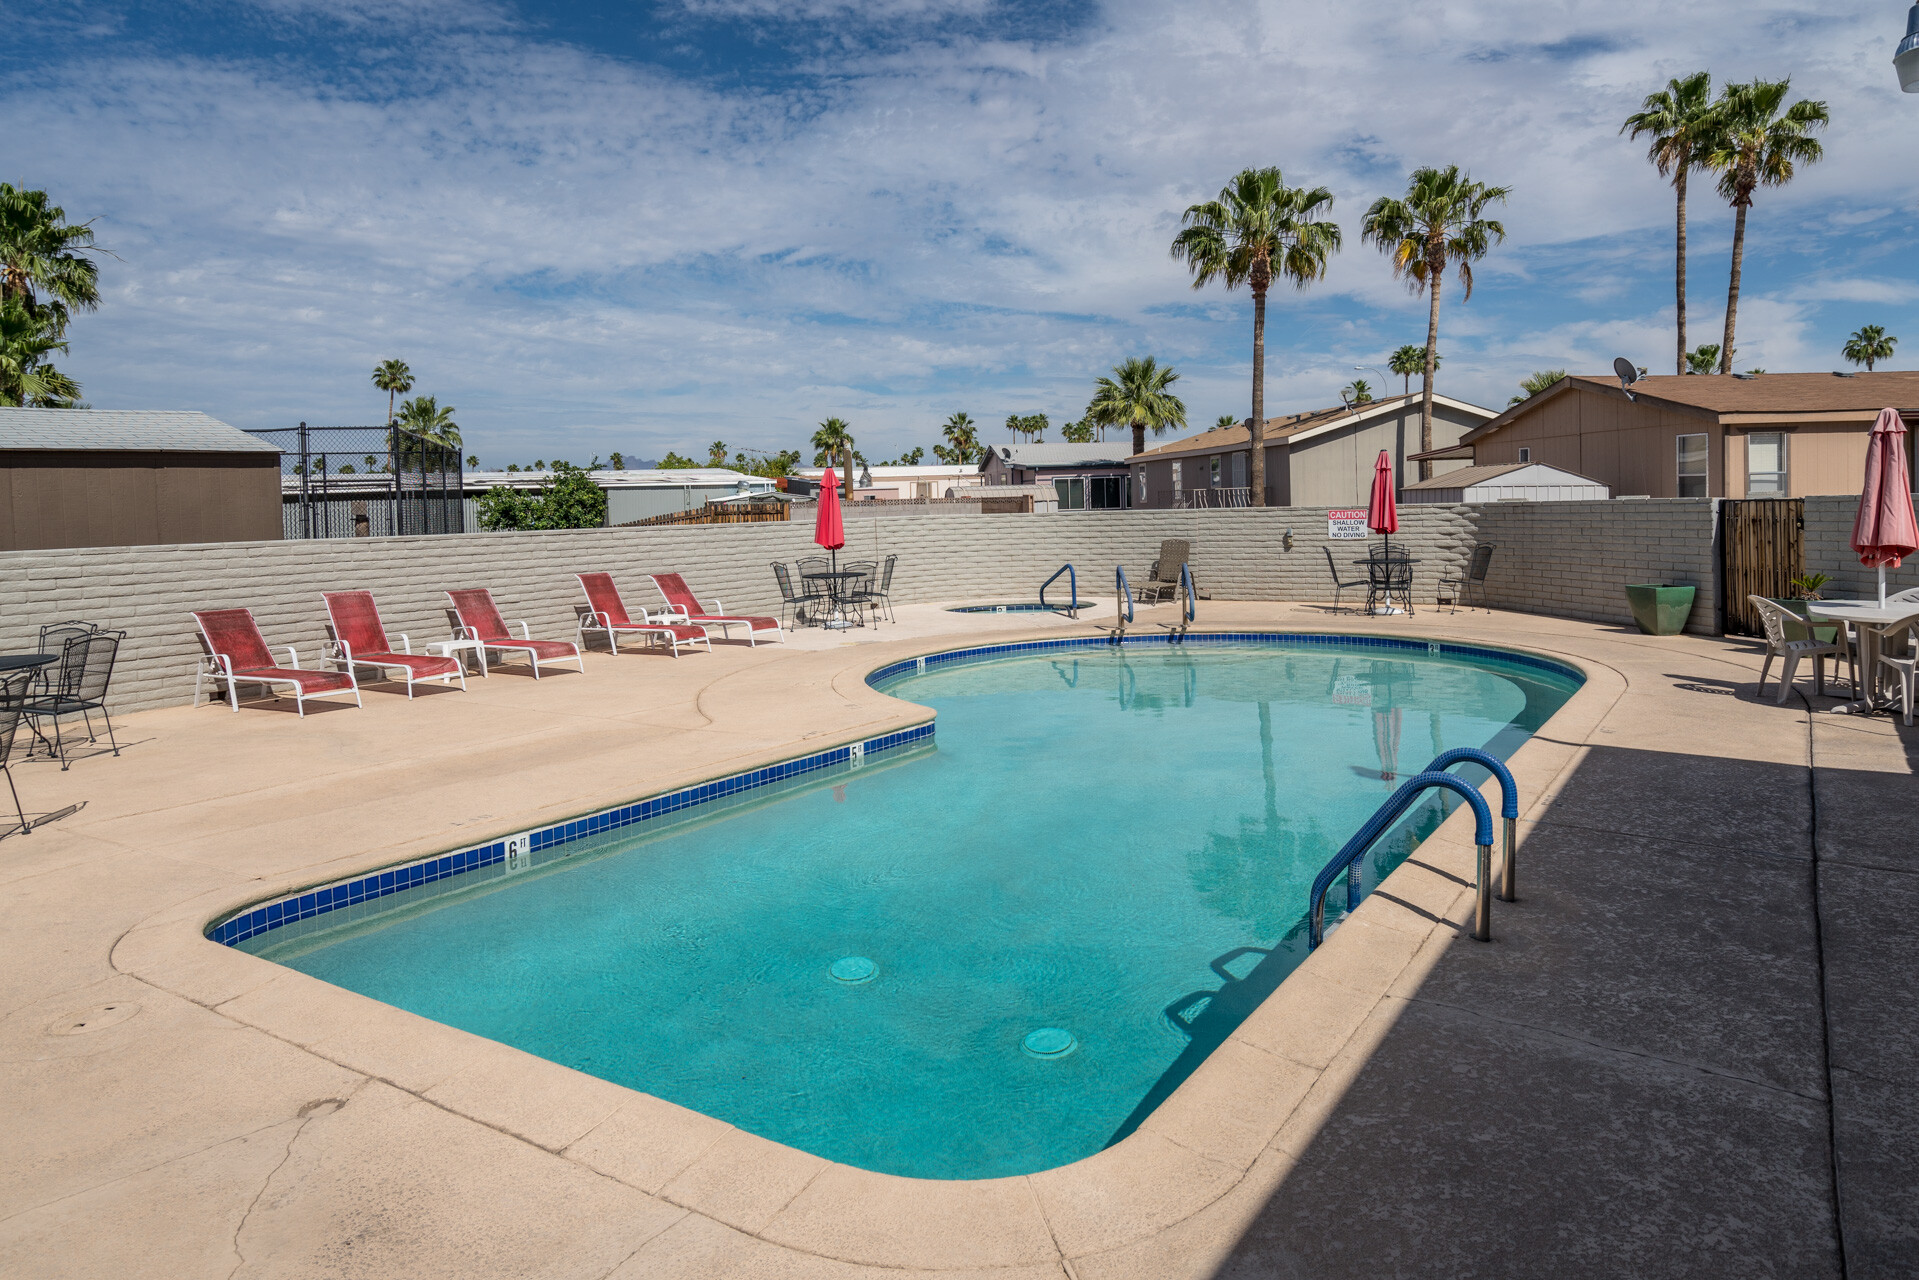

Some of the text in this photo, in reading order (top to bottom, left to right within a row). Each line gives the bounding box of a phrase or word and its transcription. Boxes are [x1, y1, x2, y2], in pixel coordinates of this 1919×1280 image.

[1330, 511, 1366, 519] CAUTION
[851, 746, 857, 759] 5
[509, 837, 526, 859] 6 FT
